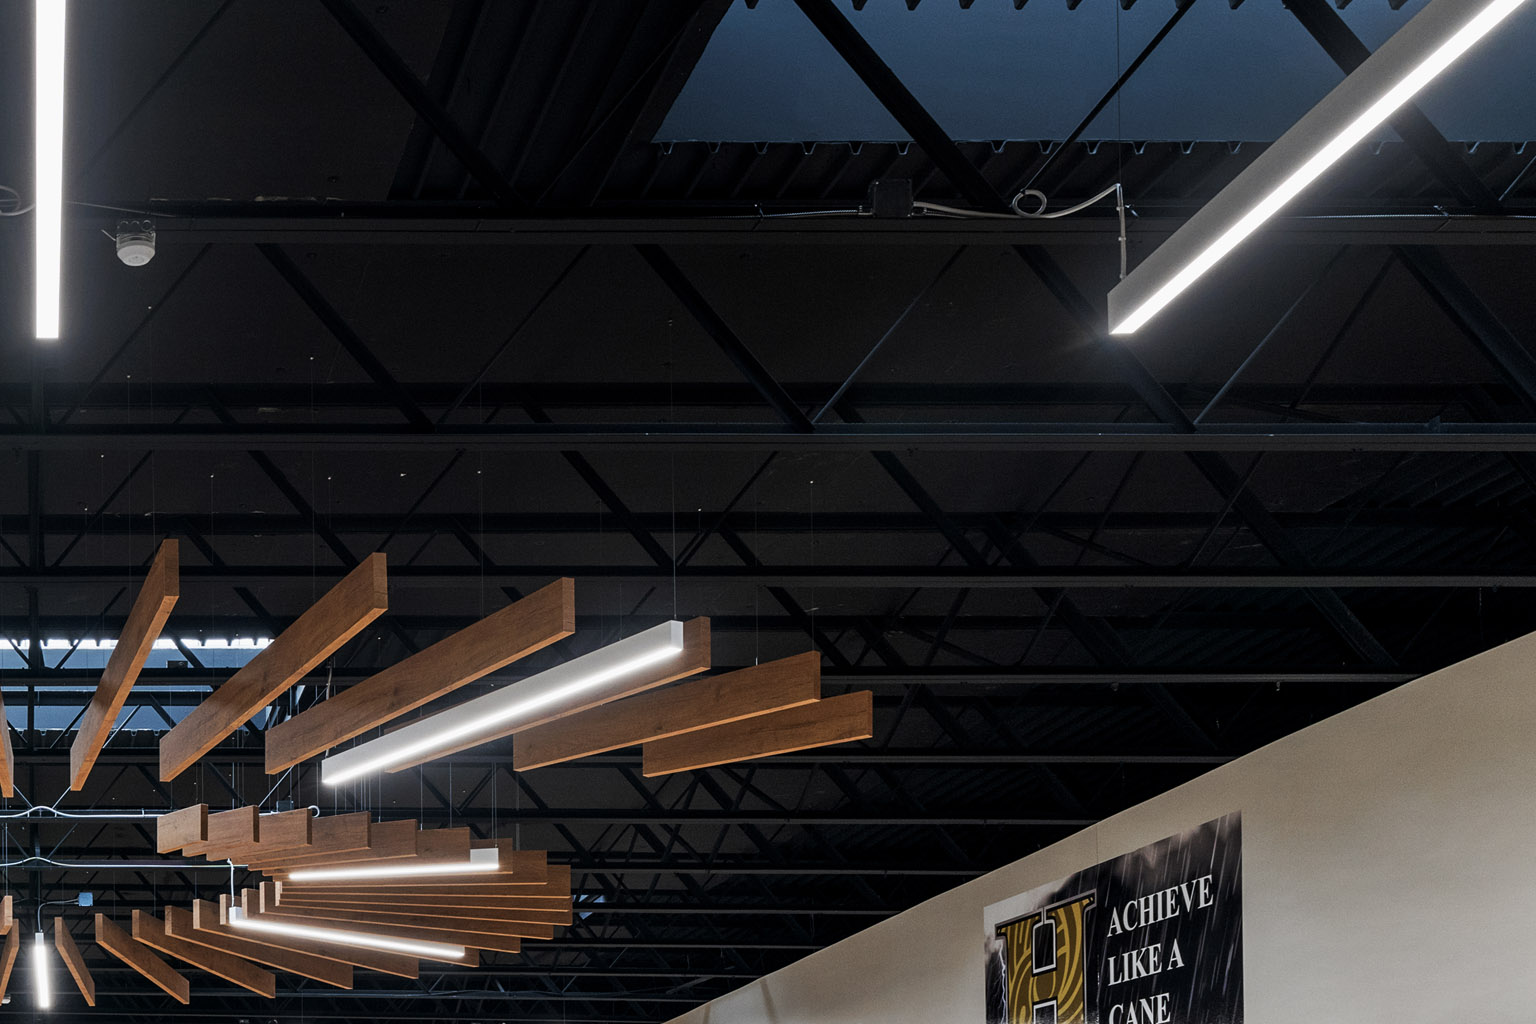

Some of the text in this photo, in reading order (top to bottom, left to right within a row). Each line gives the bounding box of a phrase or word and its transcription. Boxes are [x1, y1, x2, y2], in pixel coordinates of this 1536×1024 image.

[1106, 873, 1214, 938] ACHIEVE
[1107, 937, 1185, 987] LIKE A
